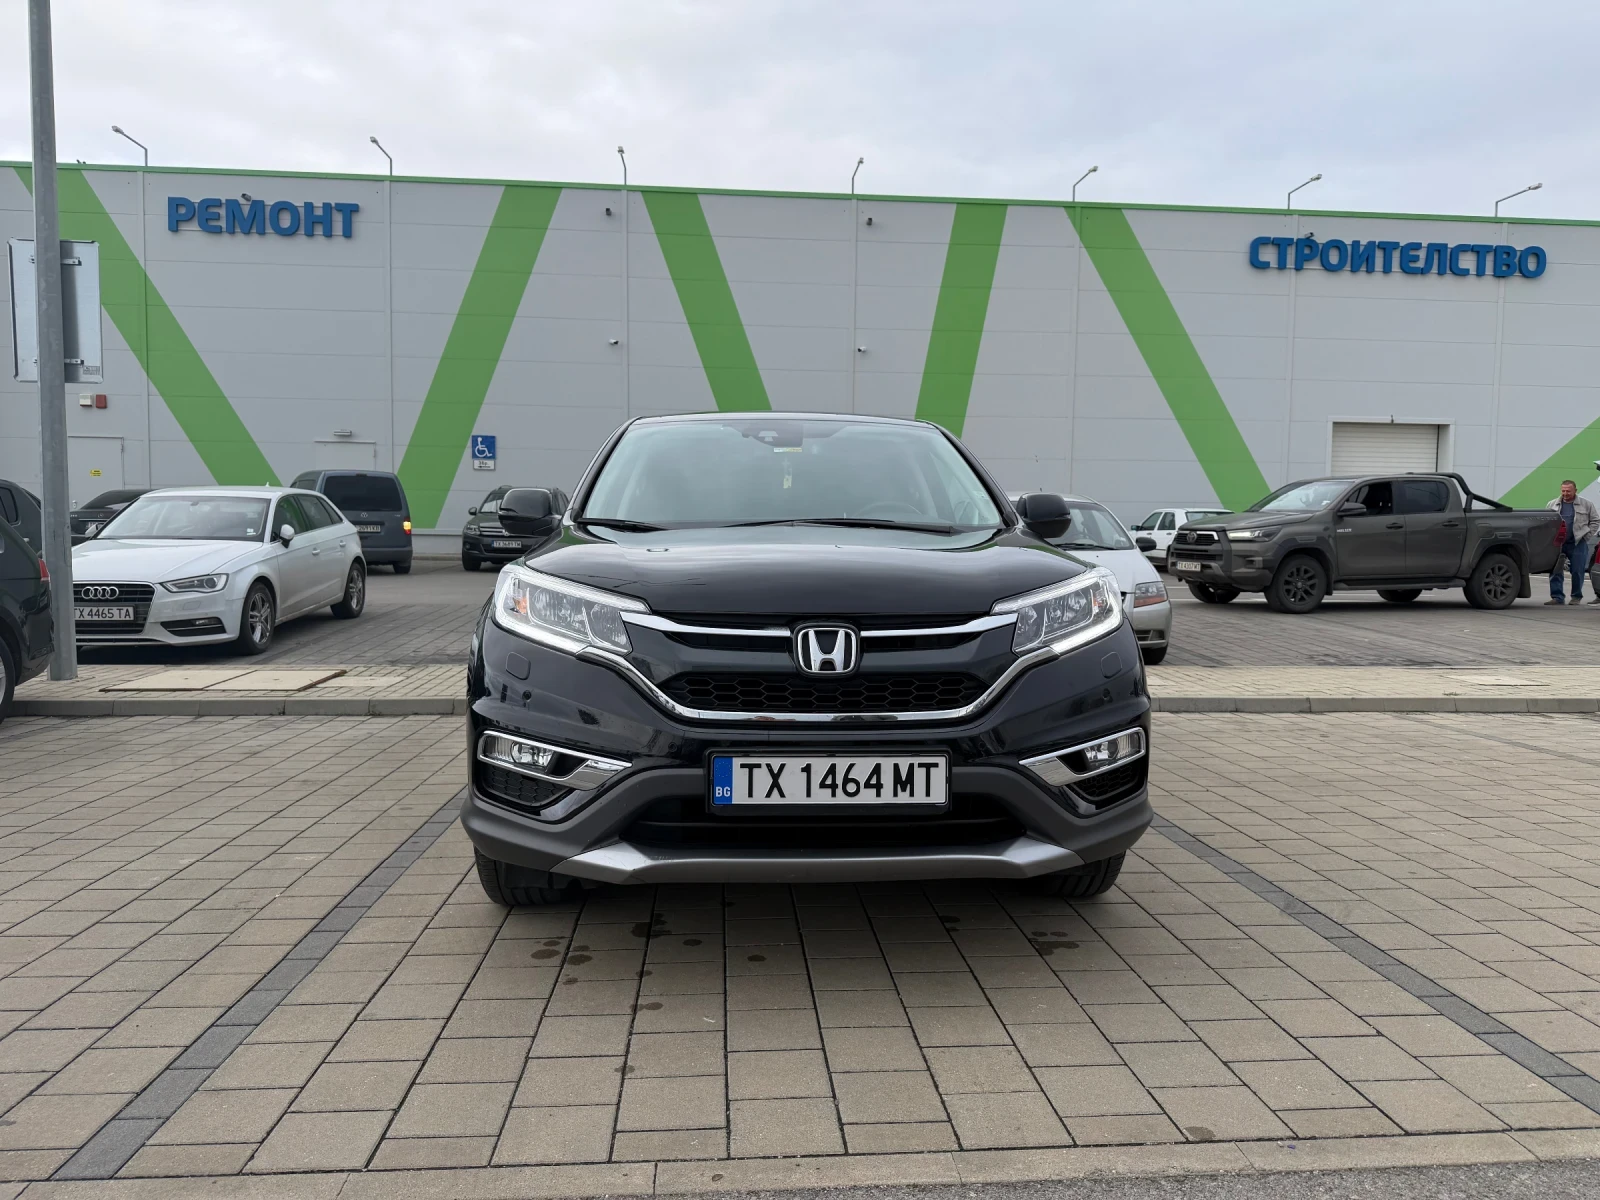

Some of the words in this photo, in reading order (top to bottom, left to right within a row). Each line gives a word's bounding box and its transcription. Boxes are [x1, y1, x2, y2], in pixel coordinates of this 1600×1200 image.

[168, 197, 359, 237] РЕМОНТ
[1250, 236, 1547, 278] СТРОИТЕЛСТВО
[87, 608, 114, 619] 4465
[116, 608, 131, 619] TA
[715, 786, 731, 798] BG
[739, 762, 787, 798] TX
[800, 762, 884, 798] 1464
[892, 762, 939, 798] MT
